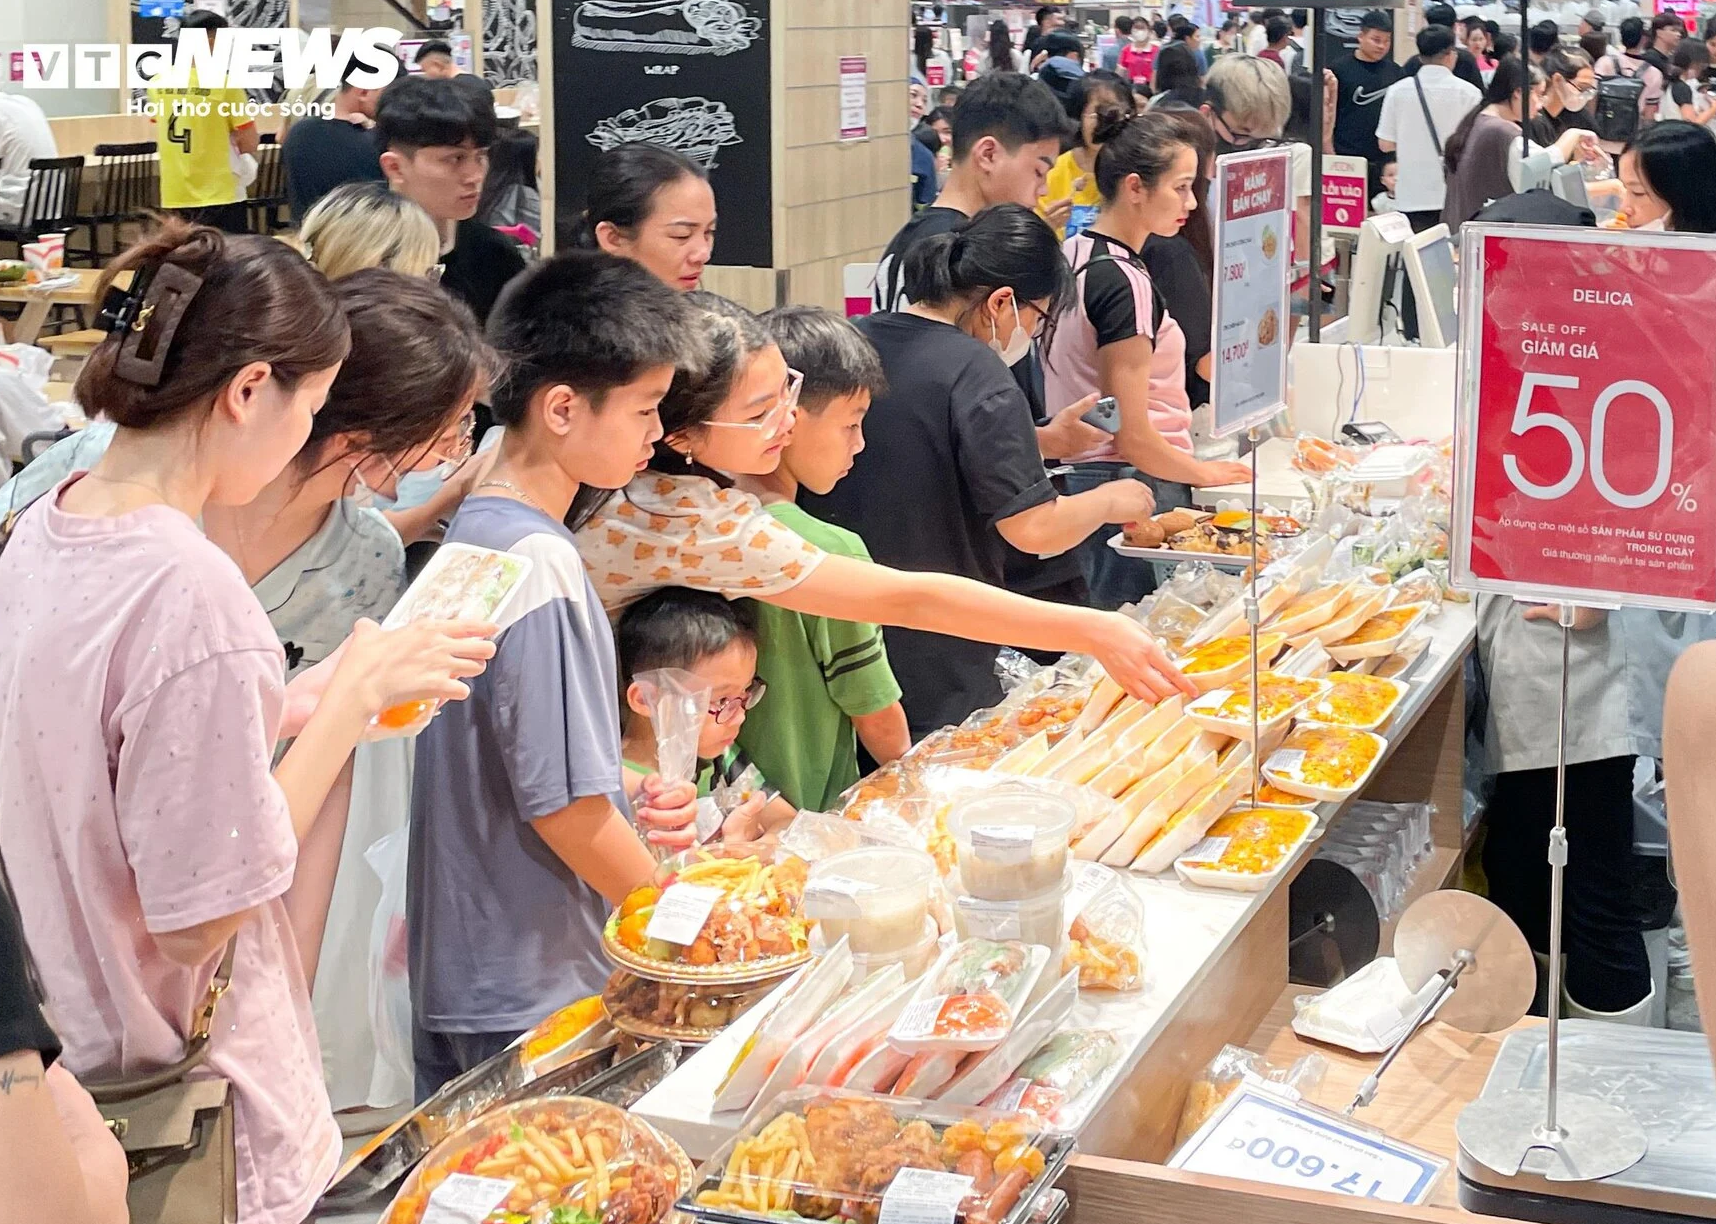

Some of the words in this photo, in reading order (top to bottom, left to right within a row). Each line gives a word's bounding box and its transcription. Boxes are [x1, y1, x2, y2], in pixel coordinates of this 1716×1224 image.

[644, 65, 680, 74] WRAP
[167, 104, 191, 154] 4
[1573, 288, 1634, 307] DELICA
[1521, 321, 1556, 334] SALE
[1560, 324, 1587, 336] OFF
[1521, 336, 1565, 357] GIẢM
[1569, 341, 1600, 360] GIÁ
[1513, 518, 1536, 531] dụng
[1538, 520, 1556, 531] cho
[1626, 542, 1663, 555] TRONG
